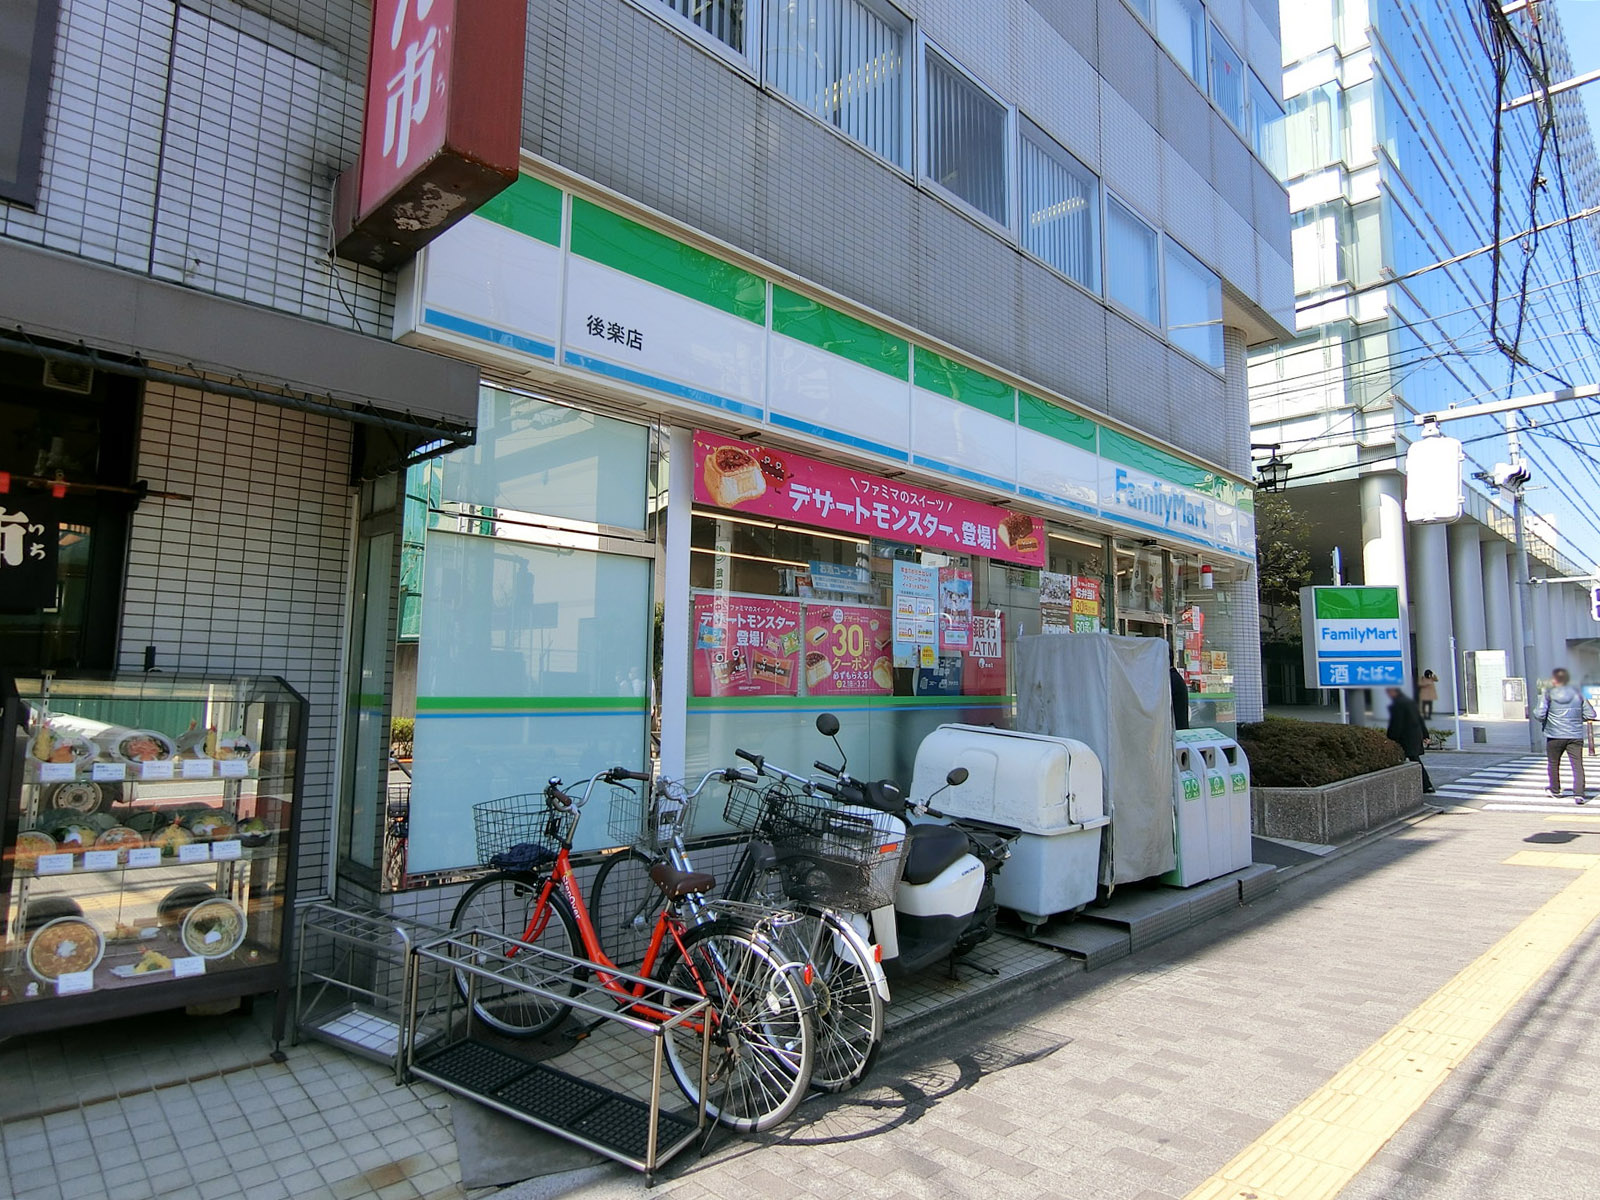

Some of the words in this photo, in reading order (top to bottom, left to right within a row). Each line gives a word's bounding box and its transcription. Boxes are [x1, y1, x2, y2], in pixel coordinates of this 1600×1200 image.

[586, 314, 644, 352] 後楽店
[861, 479, 945, 512] ファミマのスイーツ
[1115, 467, 1208, 530] FamilyMart
[788, 482, 998, 551] デザートモンスター、登場!
[28, 523, 46, 561] いち
[700, 612, 796, 629] デザートモンスター
[973, 617, 996, 639] 銀行
[736, 630, 764, 648] 登場!
[832, 623, 864, 657] 30
[1321, 627, 1398, 644] FamilyMart
[973, 641, 997, 656] ATM
[832, 656, 872, 671] クーポン
[1329, 664, 1350, 684] 酒
[1356, 665, 1397, 682] たばこ
[832, 671, 872, 680] 必ずもらえる!
